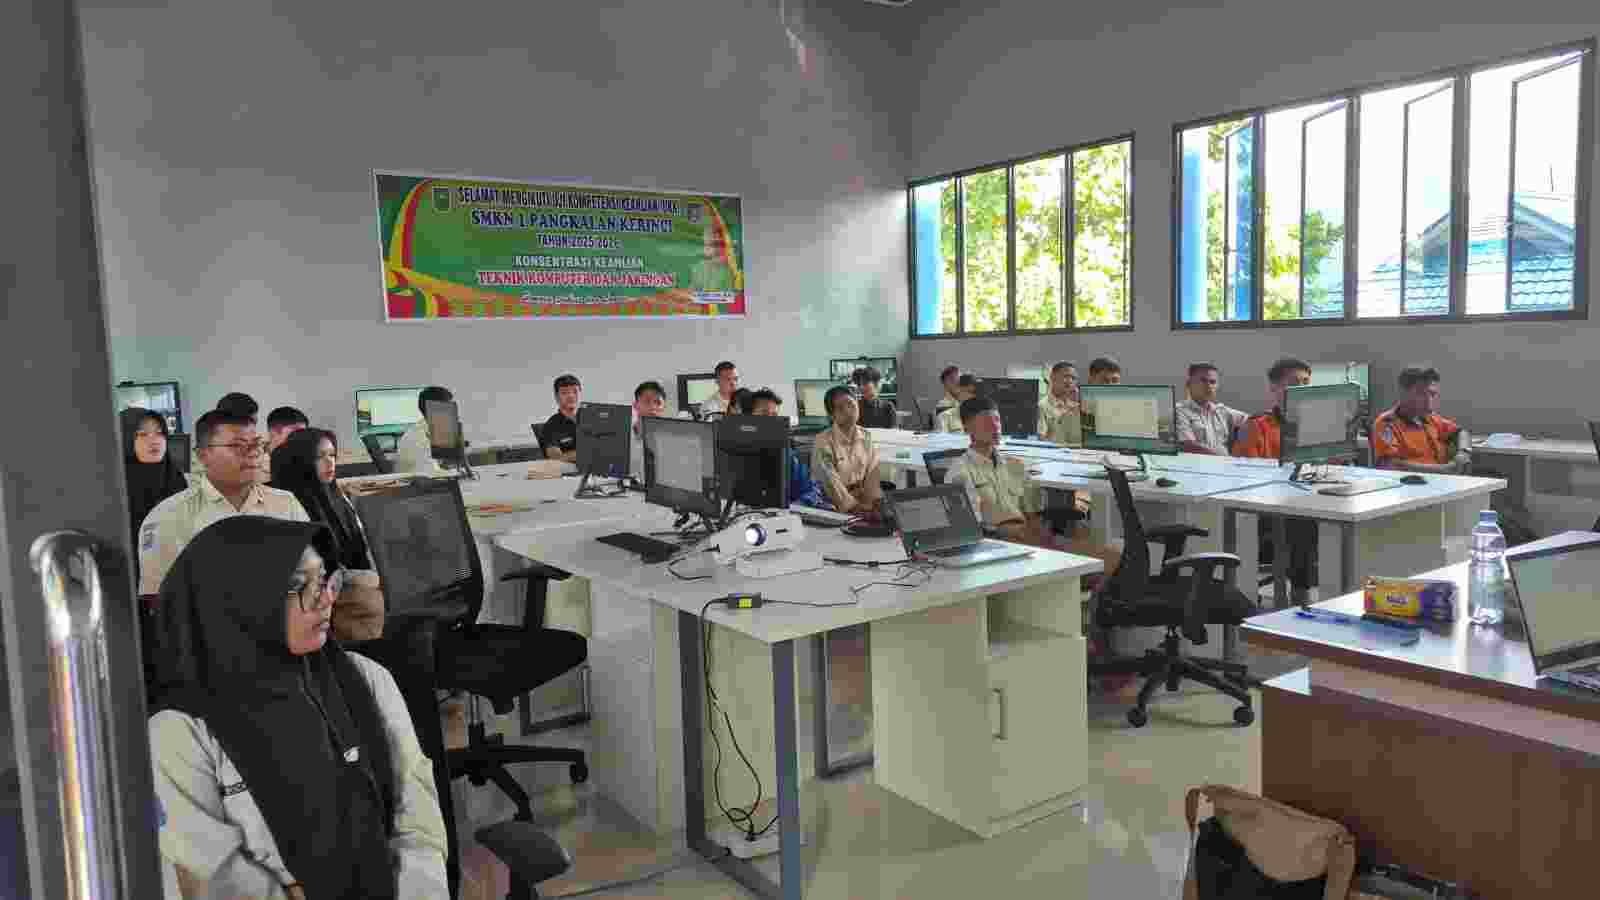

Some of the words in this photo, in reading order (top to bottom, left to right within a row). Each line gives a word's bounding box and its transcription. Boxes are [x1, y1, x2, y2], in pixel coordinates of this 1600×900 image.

[472, 210, 512, 225] SMKN
[530, 213, 617, 231] PANGKALAN
[515, 255, 590, 269] KONSENTRASI
